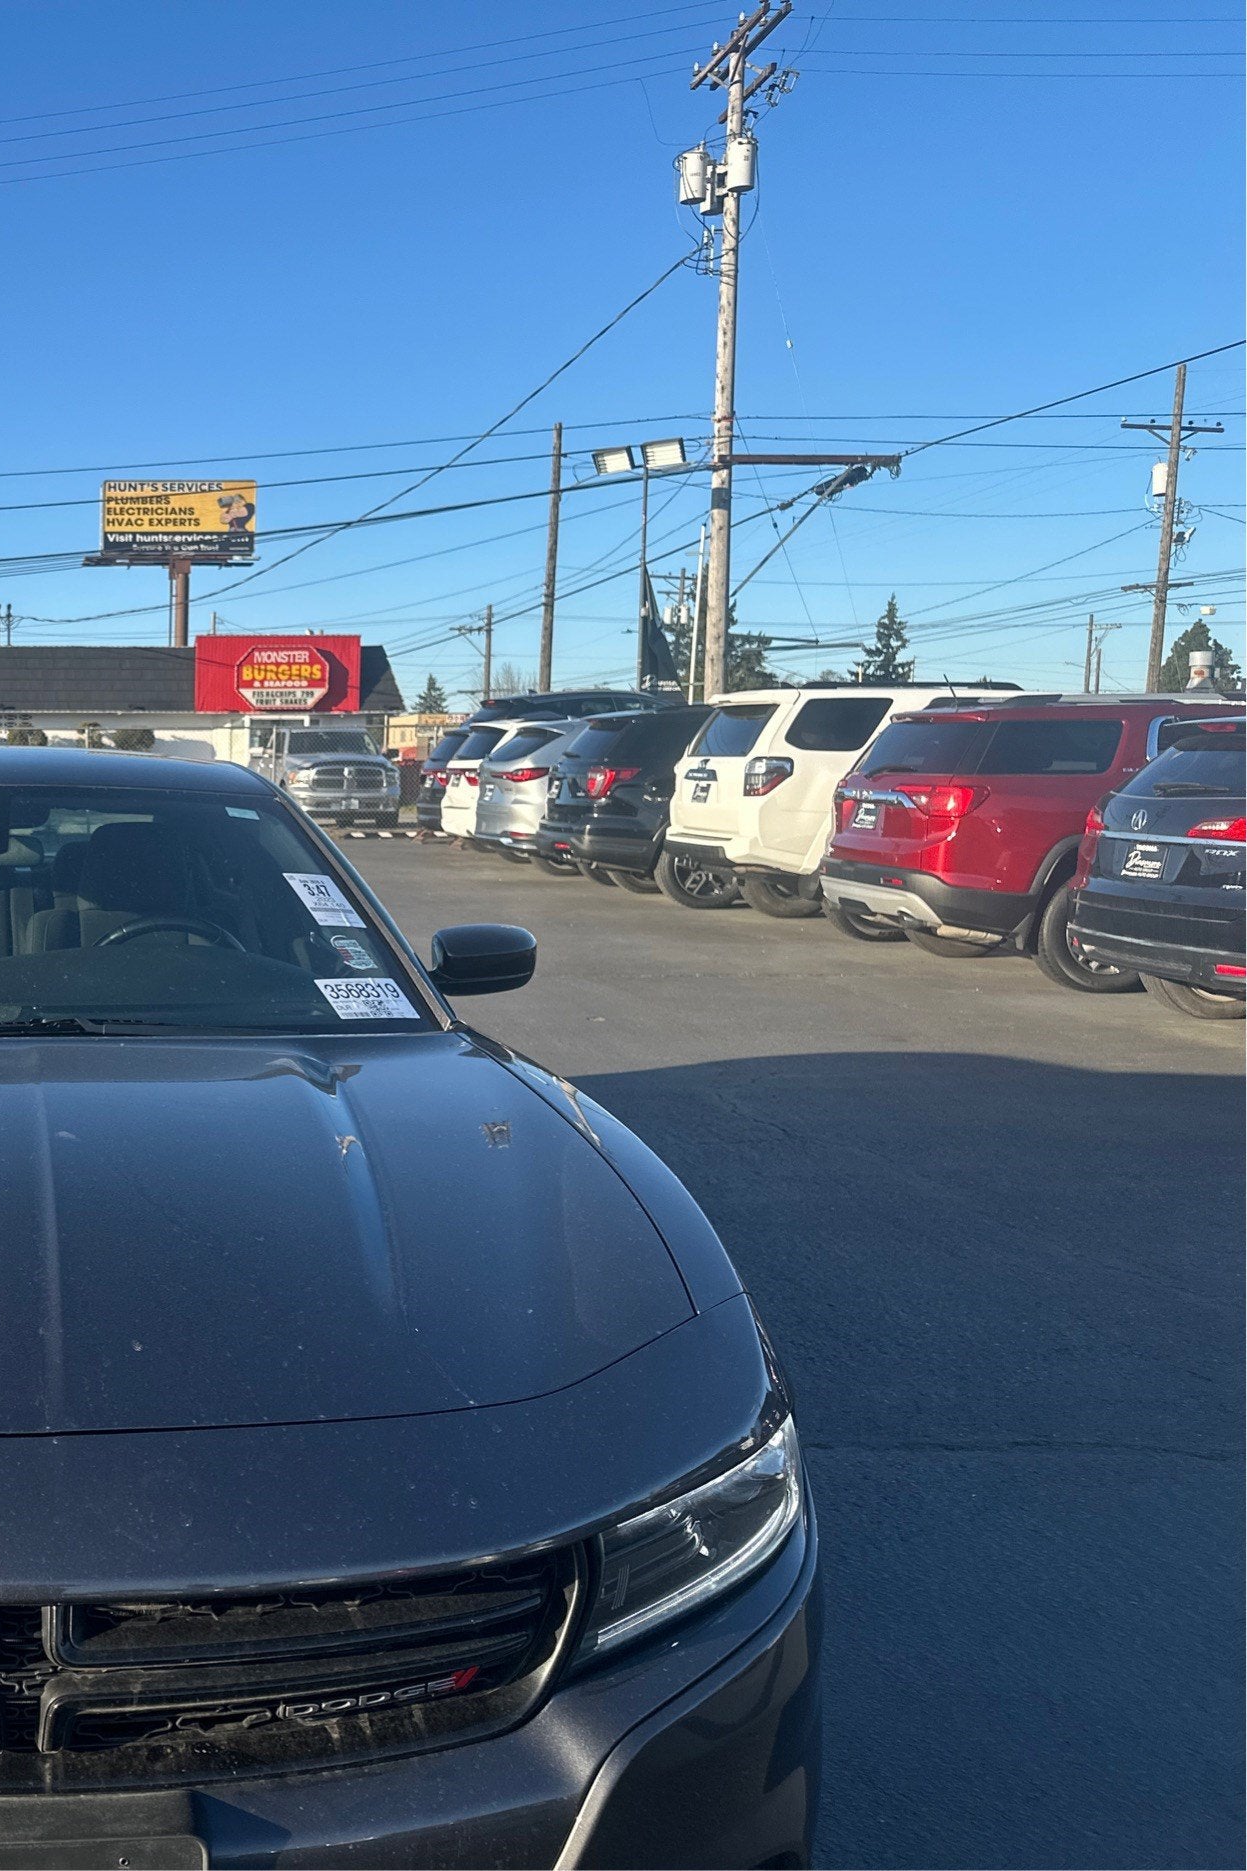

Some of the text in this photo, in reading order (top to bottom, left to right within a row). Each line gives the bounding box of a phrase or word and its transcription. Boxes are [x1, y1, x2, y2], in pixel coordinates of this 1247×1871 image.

[107, 482, 224, 493] HUNT'S SERVICES
[106, 495, 171, 505] PLUMBERS
[106, 507, 195, 516] ELECTRICIANS
[106, 518, 201, 527] HVAC EXPERTS
[107, 533, 133, 543] Visit
[253, 650, 310, 664] MONSTER
[242, 664, 322, 681] BURGERS
[255, 698, 309, 706] FRUIT SHAKES
[303, 883, 331, 897] 3:47
[323, 983, 400, 999] 3568319
[284, 1675, 457, 1720] DODGE
